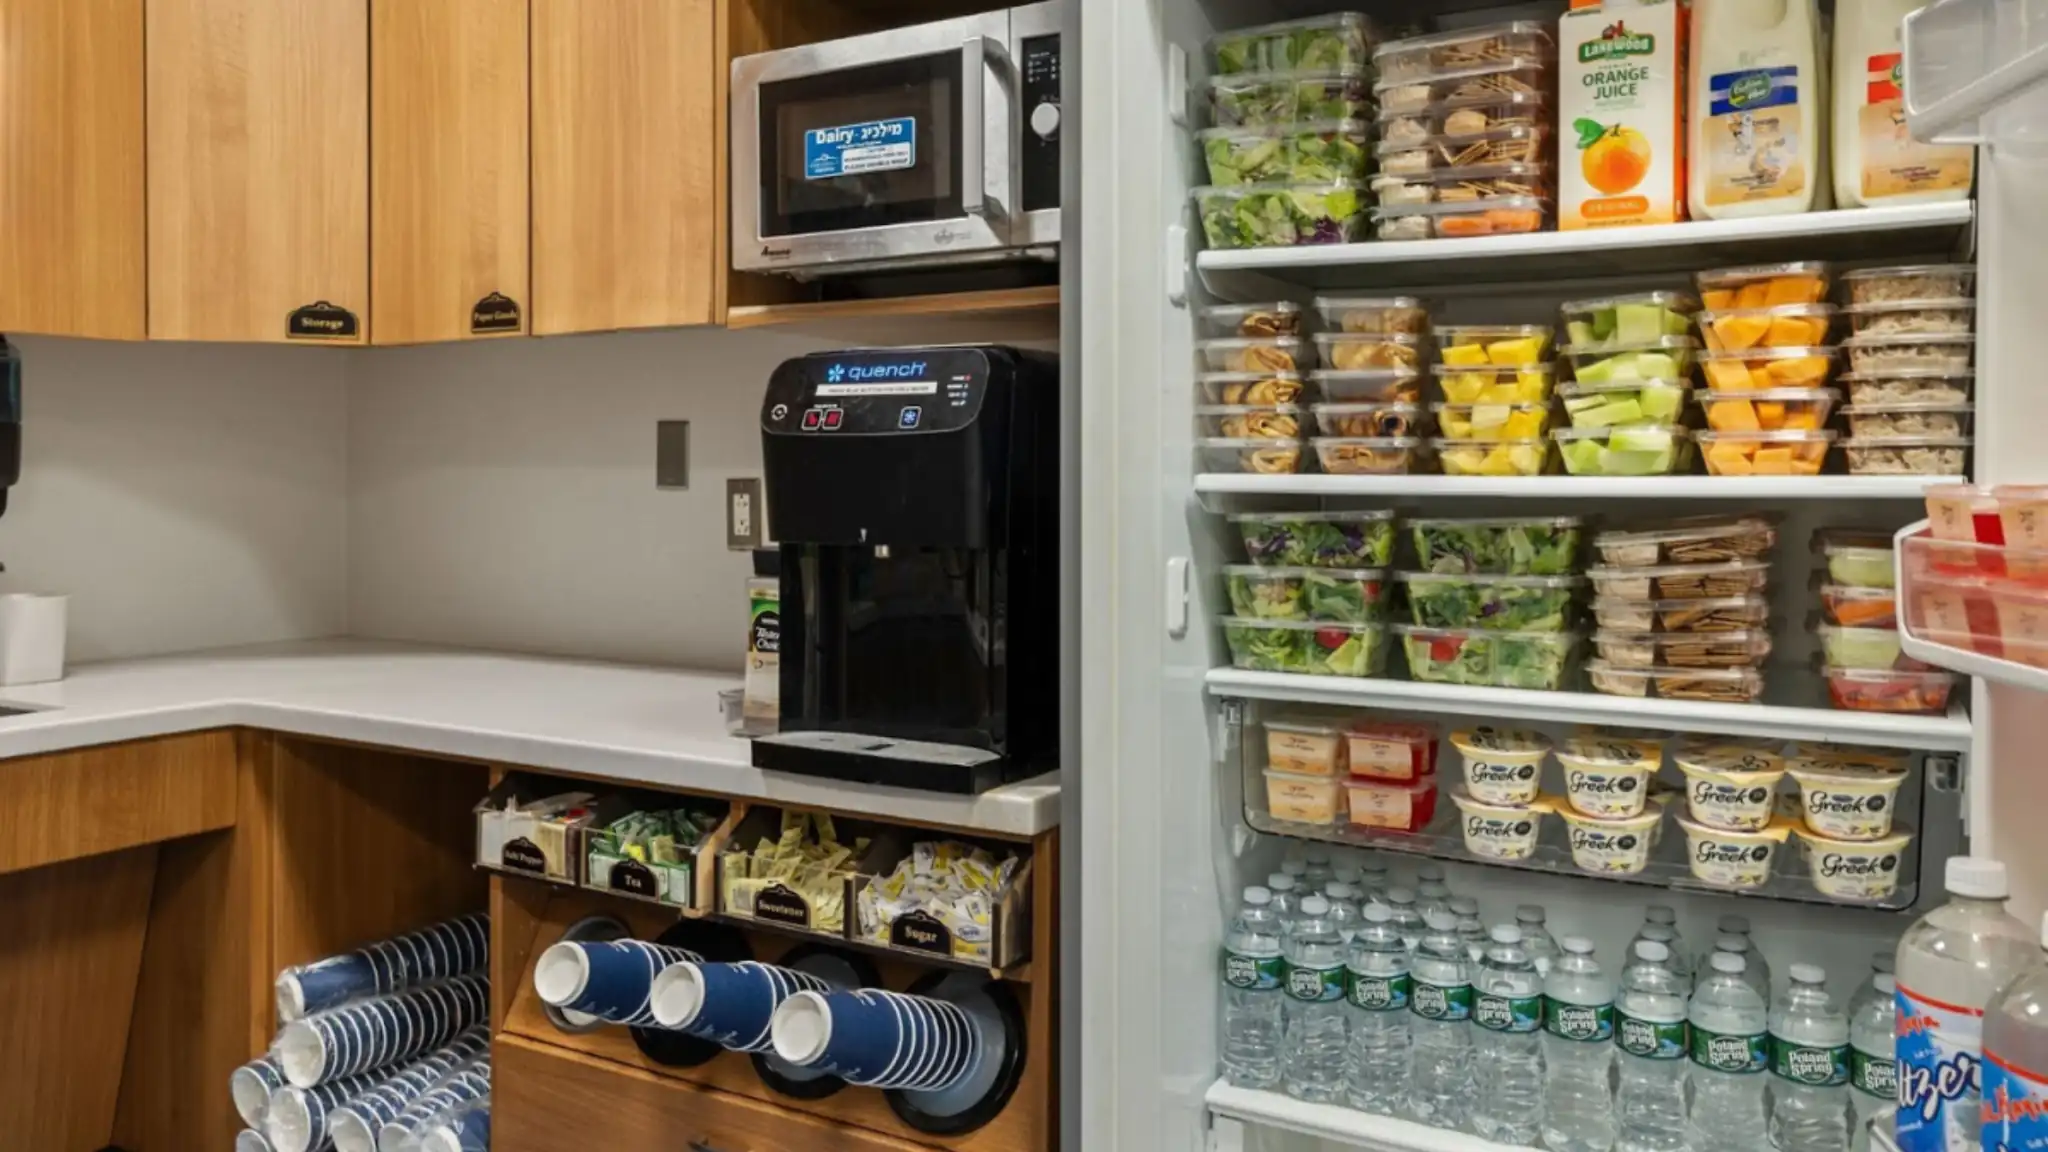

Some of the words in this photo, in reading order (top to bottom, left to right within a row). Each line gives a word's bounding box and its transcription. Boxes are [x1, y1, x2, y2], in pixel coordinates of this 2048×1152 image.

[1582, 66, 1649, 87] ORANGE
[1593, 83, 1638, 100] JUICE
[816, 128, 854, 144] Dairy
[301, 317, 344, 330] Storage
[848, 361, 924, 380] quench
[1471, 762, 1517, 784] Greek
[1570, 770, 1617, 794] Greek
[1694, 781, 1748, 804] Greek
[1808, 790, 1865, 814] Greek
[1468, 816, 1514, 837] Greek
[1572, 828, 1617, 851] Greek
[1696, 840, 1750, 864] Greek
[1821, 853, 1879, 877] Greek
[624, 874, 642, 888] Tea
[758, 899, 805, 917] Sweetener
[904, 925, 938, 943] Sugar
[1558, 1008, 1596, 1021] Poland
[1560, 1019, 1598, 1033] Spring
[1708, 1038, 1748, 1052] Poland
[1710, 1050, 1751, 1065] Spring
[1788, 1050, 1831, 1063] Poland
[1791, 1063, 1833, 1077] Spring
